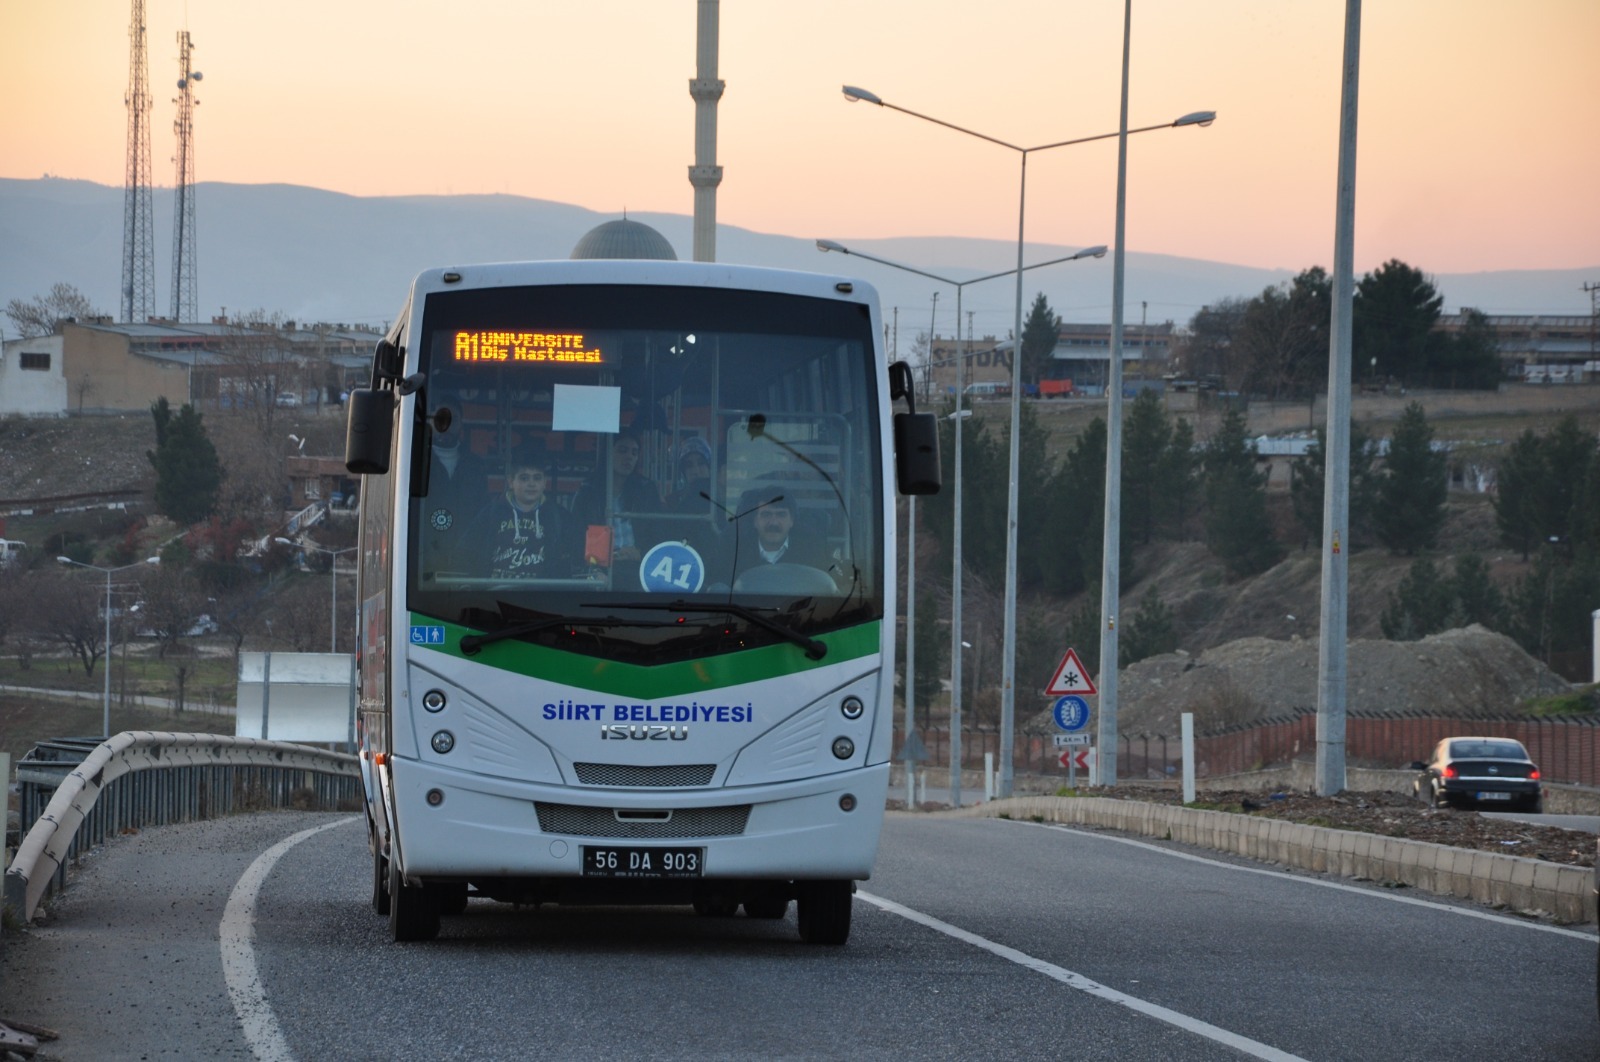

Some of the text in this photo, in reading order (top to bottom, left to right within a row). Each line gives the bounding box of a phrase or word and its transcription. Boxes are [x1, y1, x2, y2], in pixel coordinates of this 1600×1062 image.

[456, 332, 478, 360] A1
[481, 345, 601, 362] Diş Hastanesi
[650, 556, 692, 590] A1
[613, 702, 753, 723] BELEDİYESİ
[601, 724, 689, 741] ISUZU
[595, 851, 697, 871] 56 DA 903
